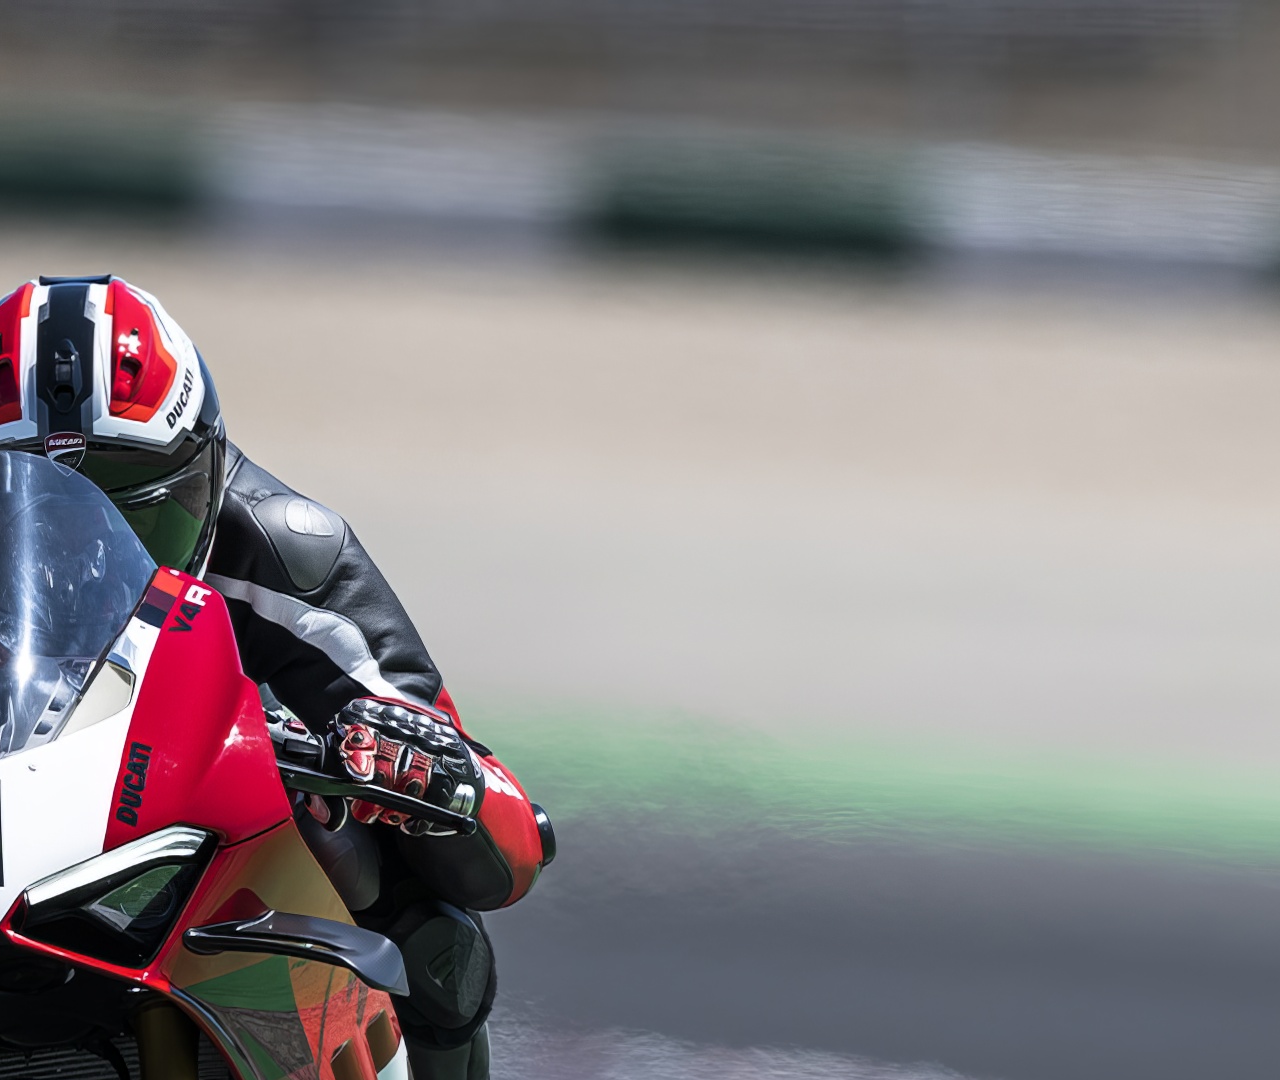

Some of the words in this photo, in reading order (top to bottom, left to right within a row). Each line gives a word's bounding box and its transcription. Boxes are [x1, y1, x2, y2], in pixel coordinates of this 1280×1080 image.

[166, 367, 194, 430] DUCATI
[168, 584, 212, 632] V4R
[116, 741, 153, 828] DUCATI
